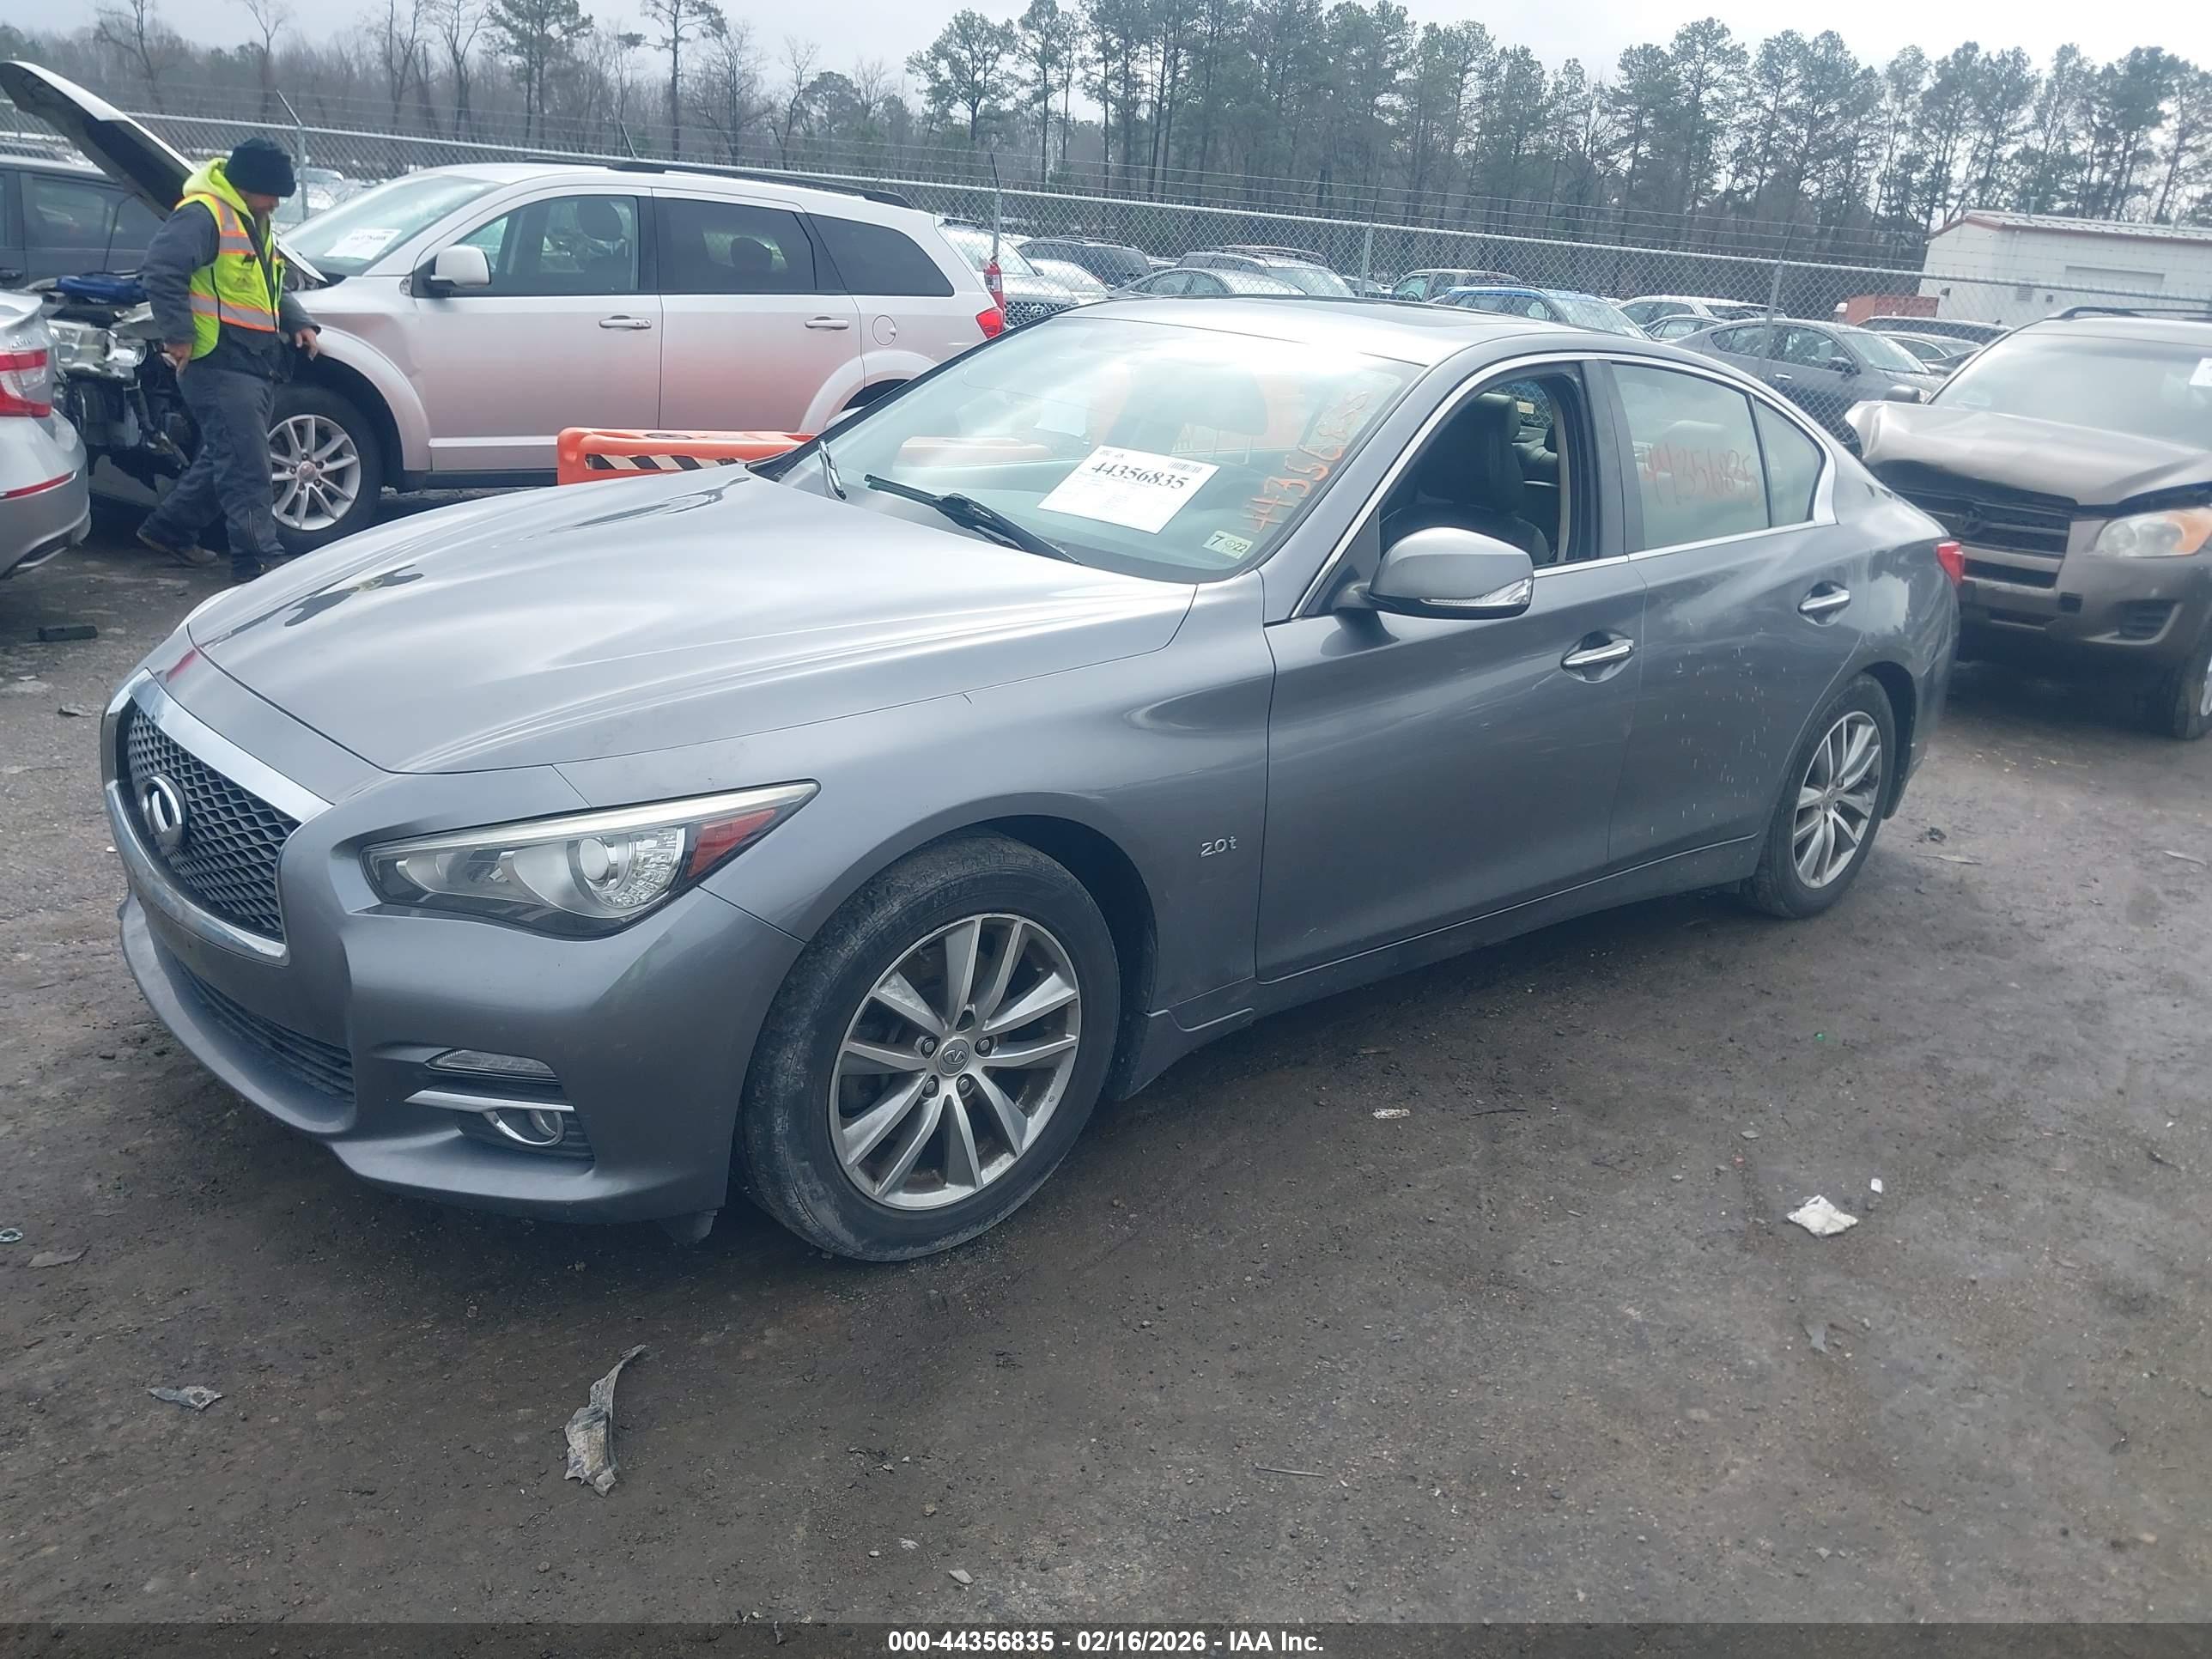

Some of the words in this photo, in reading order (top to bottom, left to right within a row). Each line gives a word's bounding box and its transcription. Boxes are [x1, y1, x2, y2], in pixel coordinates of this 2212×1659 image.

[1091, 462, 1189, 489] 44356835
[1210, 534, 1225, 546] 7
[1231, 541, 1249, 554] 22
